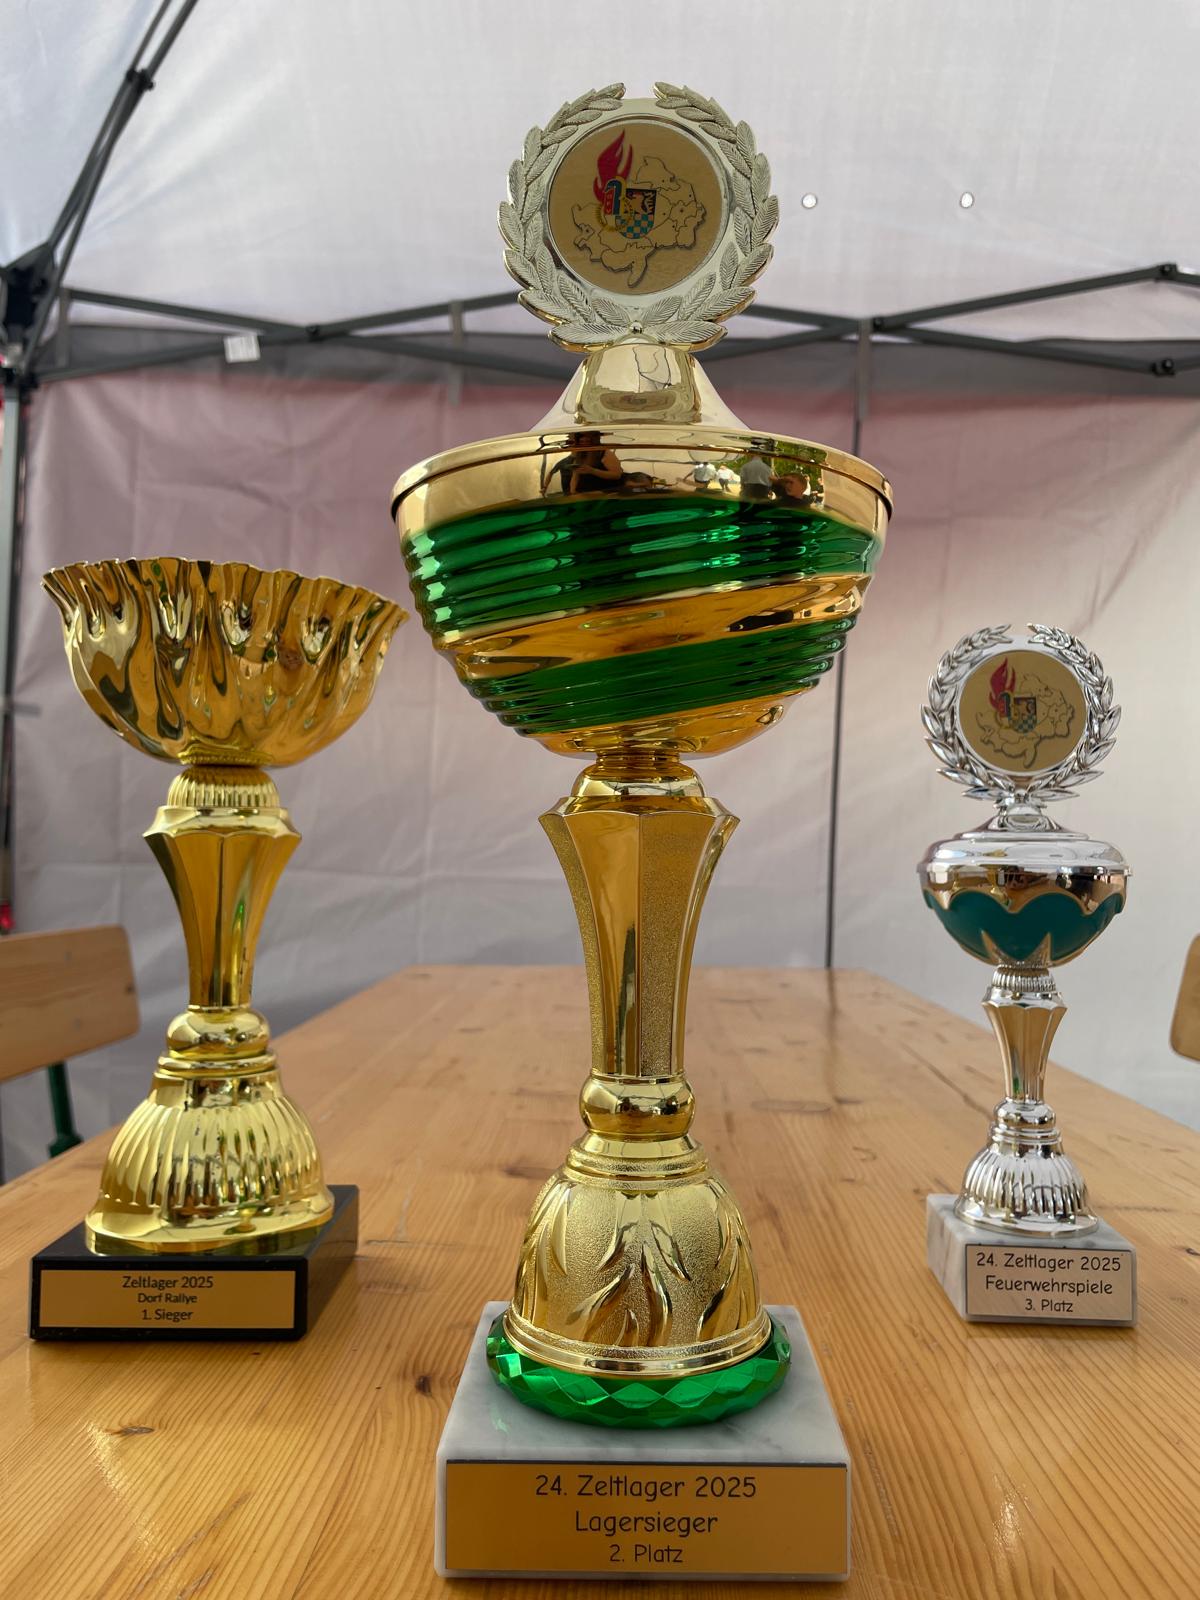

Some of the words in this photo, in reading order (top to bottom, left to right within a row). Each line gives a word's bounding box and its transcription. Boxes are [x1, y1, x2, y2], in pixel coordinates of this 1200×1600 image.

[976, 1252, 998, 1267] 24.
[1004, 1253, 1074, 1272] Zeltlager
[1080, 1256, 1121, 1271] 2025
[122, 1276, 179, 1291] Zeltlager
[181, 1276, 213, 1289] 2025
[985, 1275, 1113, 1296] Feuerwehrspiele
[137, 1293, 163, 1304] Dorf
[165, 1293, 198, 1304] Rallye
[1025, 1299, 1035, 1311] 3.
[1041, 1299, 1073, 1312] Platz
[142, 1309, 151, 1320] 1.
[154, 1309, 194, 1322] Sieger
[535, 1475, 567, 1496] 24.
[577, 1475, 685, 1502] Zeltlager
[695, 1476, 756, 1497] 2025
[575, 1510, 718, 1537] Lagersieger
[610, 1544, 624, 1562] 2.
[634, 1544, 683, 1563] Platz
